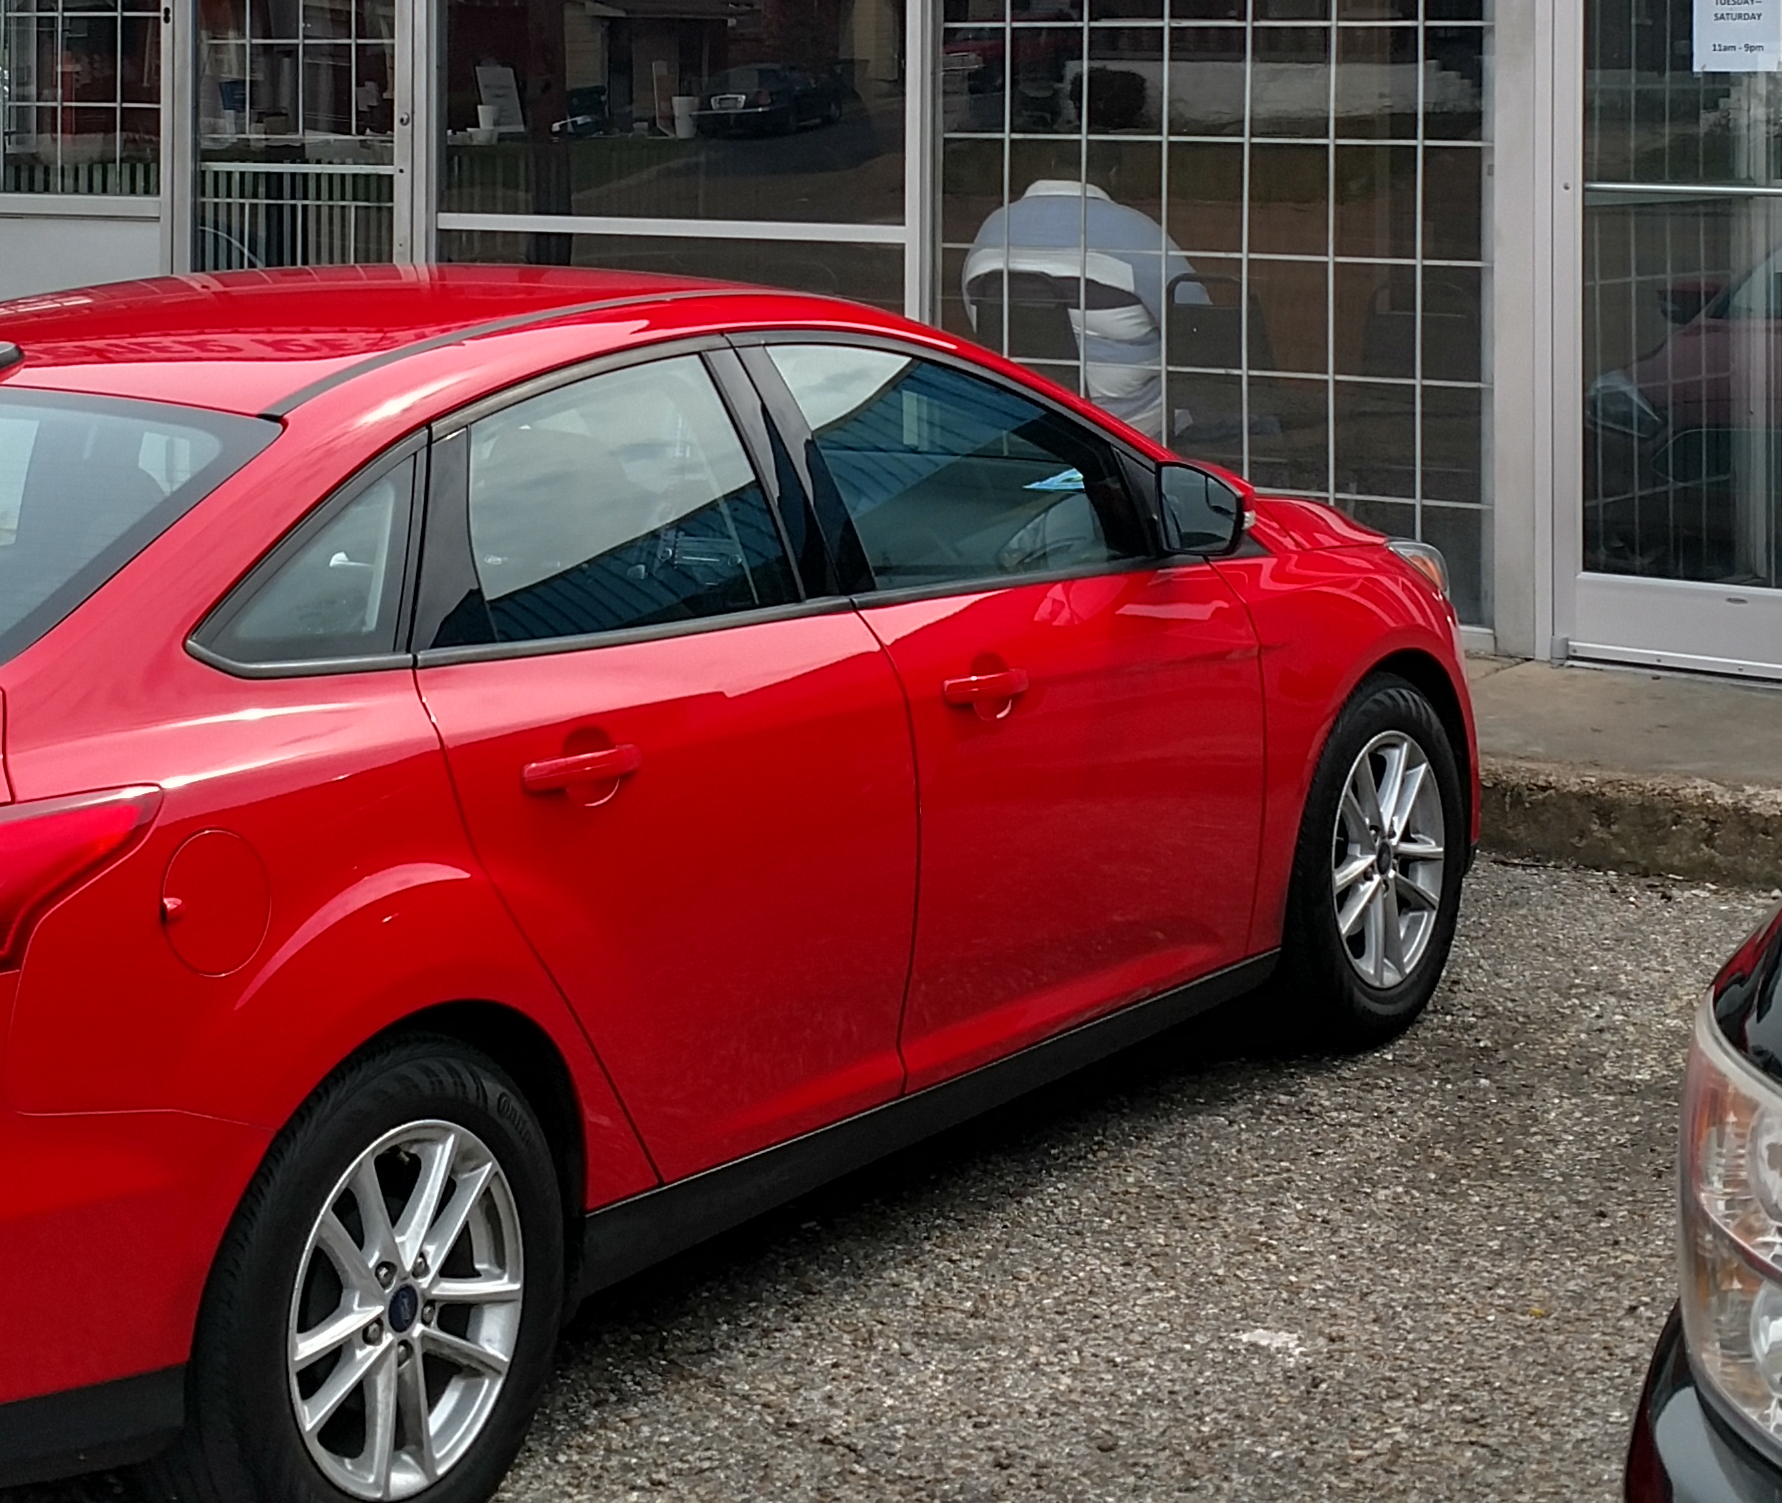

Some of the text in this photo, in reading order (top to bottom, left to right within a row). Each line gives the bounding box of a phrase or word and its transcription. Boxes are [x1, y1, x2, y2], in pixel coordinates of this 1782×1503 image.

[1713, 12, 1762, 21] SATURDAY
[1712, 43, 1736, 52] 11am
[1744, 43, 1764, 53] 9pm
